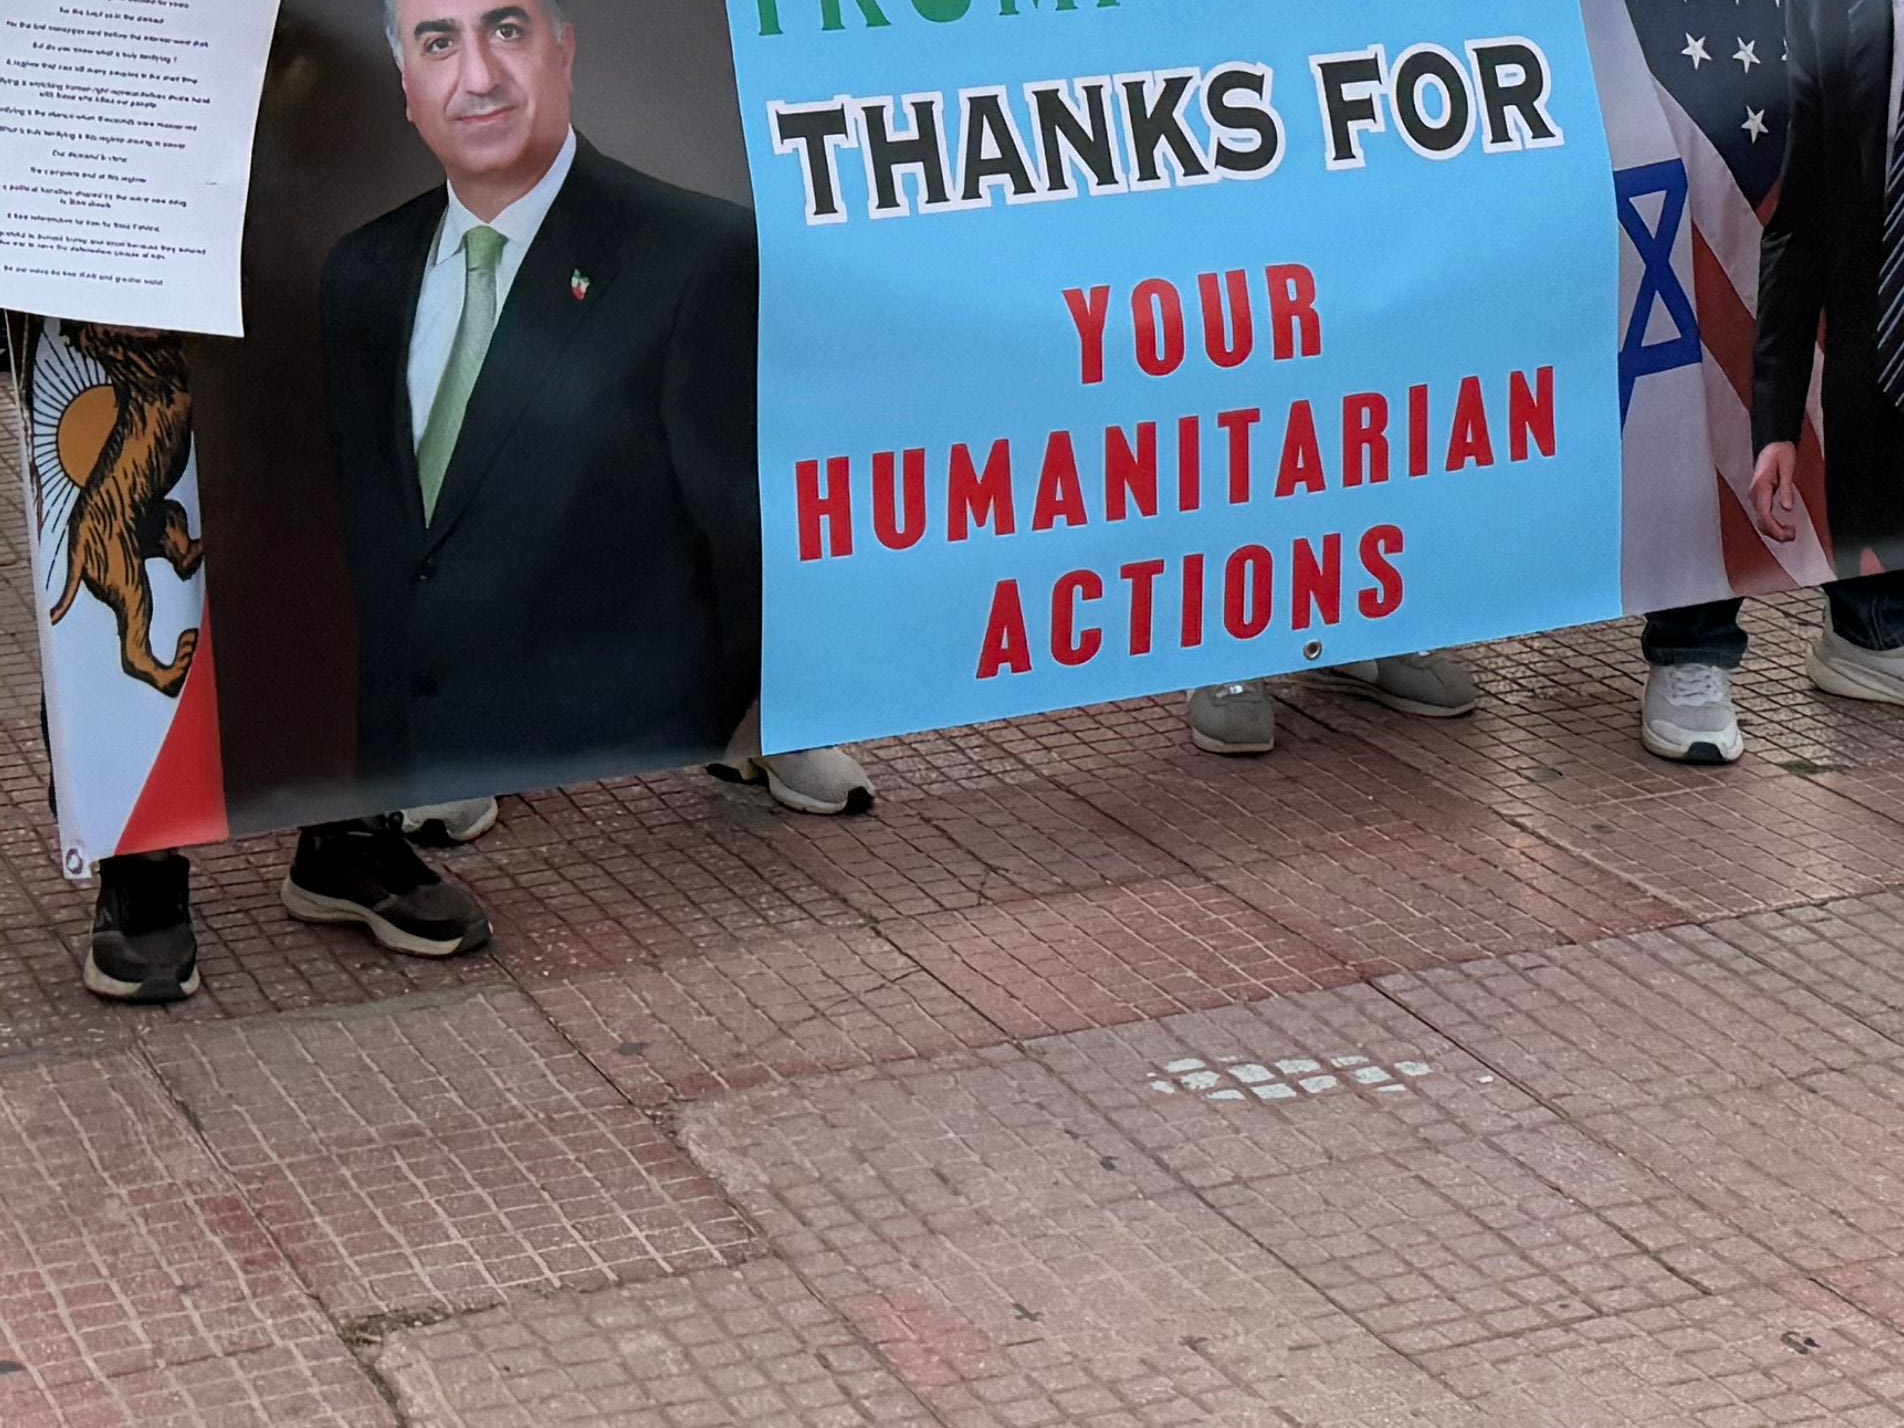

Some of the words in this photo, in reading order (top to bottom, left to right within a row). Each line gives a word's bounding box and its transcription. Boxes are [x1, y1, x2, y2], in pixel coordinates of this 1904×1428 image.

[768, 60, 1280, 225] THANKS
[1312, 35, 1565, 171] FOR
[1062, 263, 1323, 385] YOUR
[795, 366, 1555, 563] HUMANITARIAN
[976, 524, 1405, 680] ACTIONS
